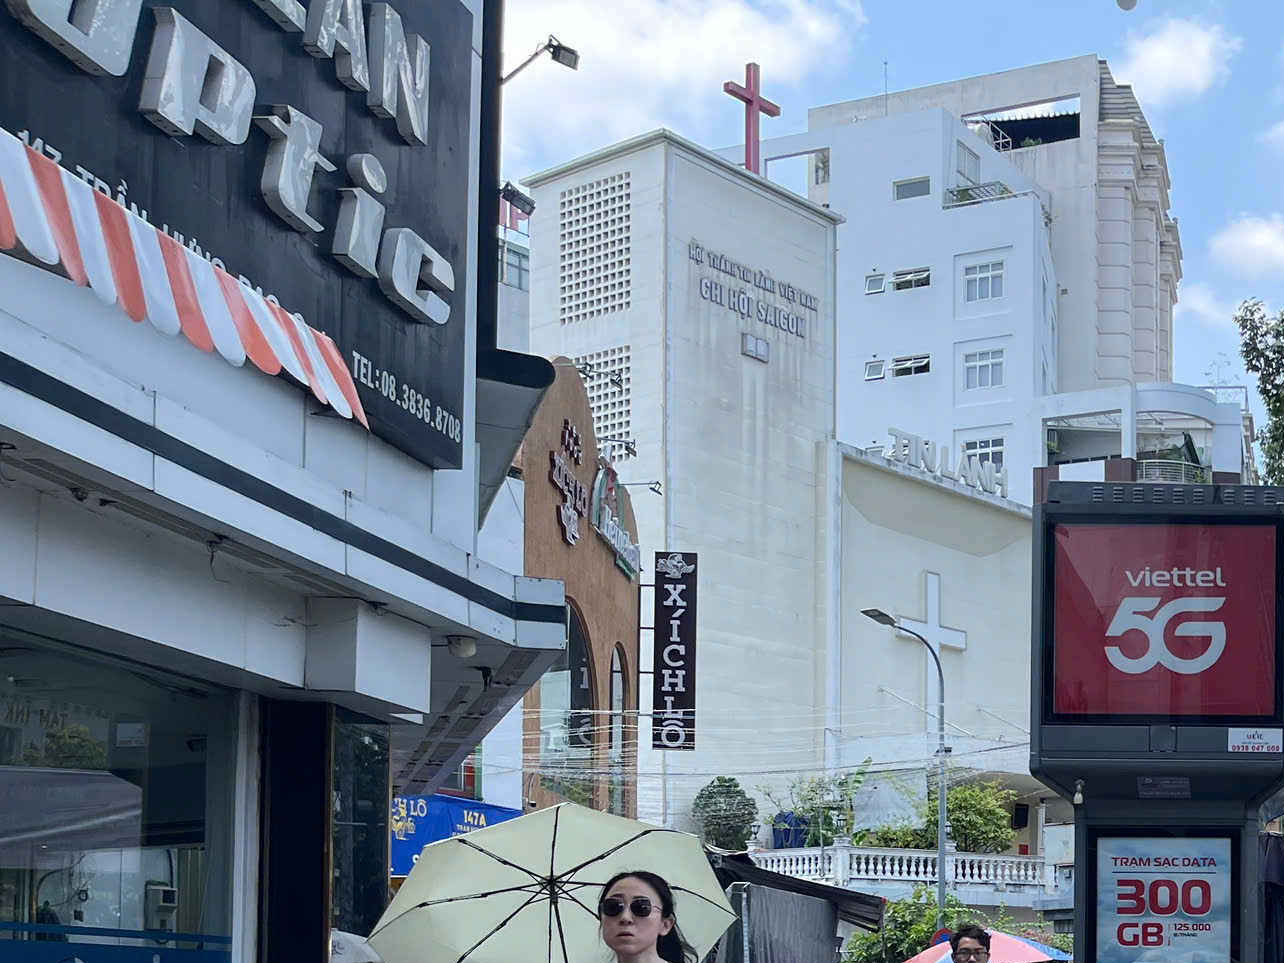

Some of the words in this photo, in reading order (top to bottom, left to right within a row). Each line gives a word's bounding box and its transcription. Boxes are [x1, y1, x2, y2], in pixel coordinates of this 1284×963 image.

[778, 281, 797, 304] VIỆT
[700, 277, 724, 307] CHI
[728, 287, 752, 320] HỘI
[756, 300, 804, 339] SAIGON
[888, 427, 936, 474] TIN
[1125, 567, 1227, 587] viettel
[661, 584, 687, 692] XÍCH
[1104, 597, 1227, 674] 5G
[660, 696, 686, 748] LÔ
[409, 798, 427, 818] LÔ
[463, 809, 487, 827] 147A
[1112, 857, 1151, 869] TRẠM
[1153, 857, 1179, 869] SẠC
[1182, 857, 1217, 868] DATA
[1117, 879, 1211, 915] 300
[1116, 922, 1164, 947] GB
[1173, 923, 1211, 932] 125.000
